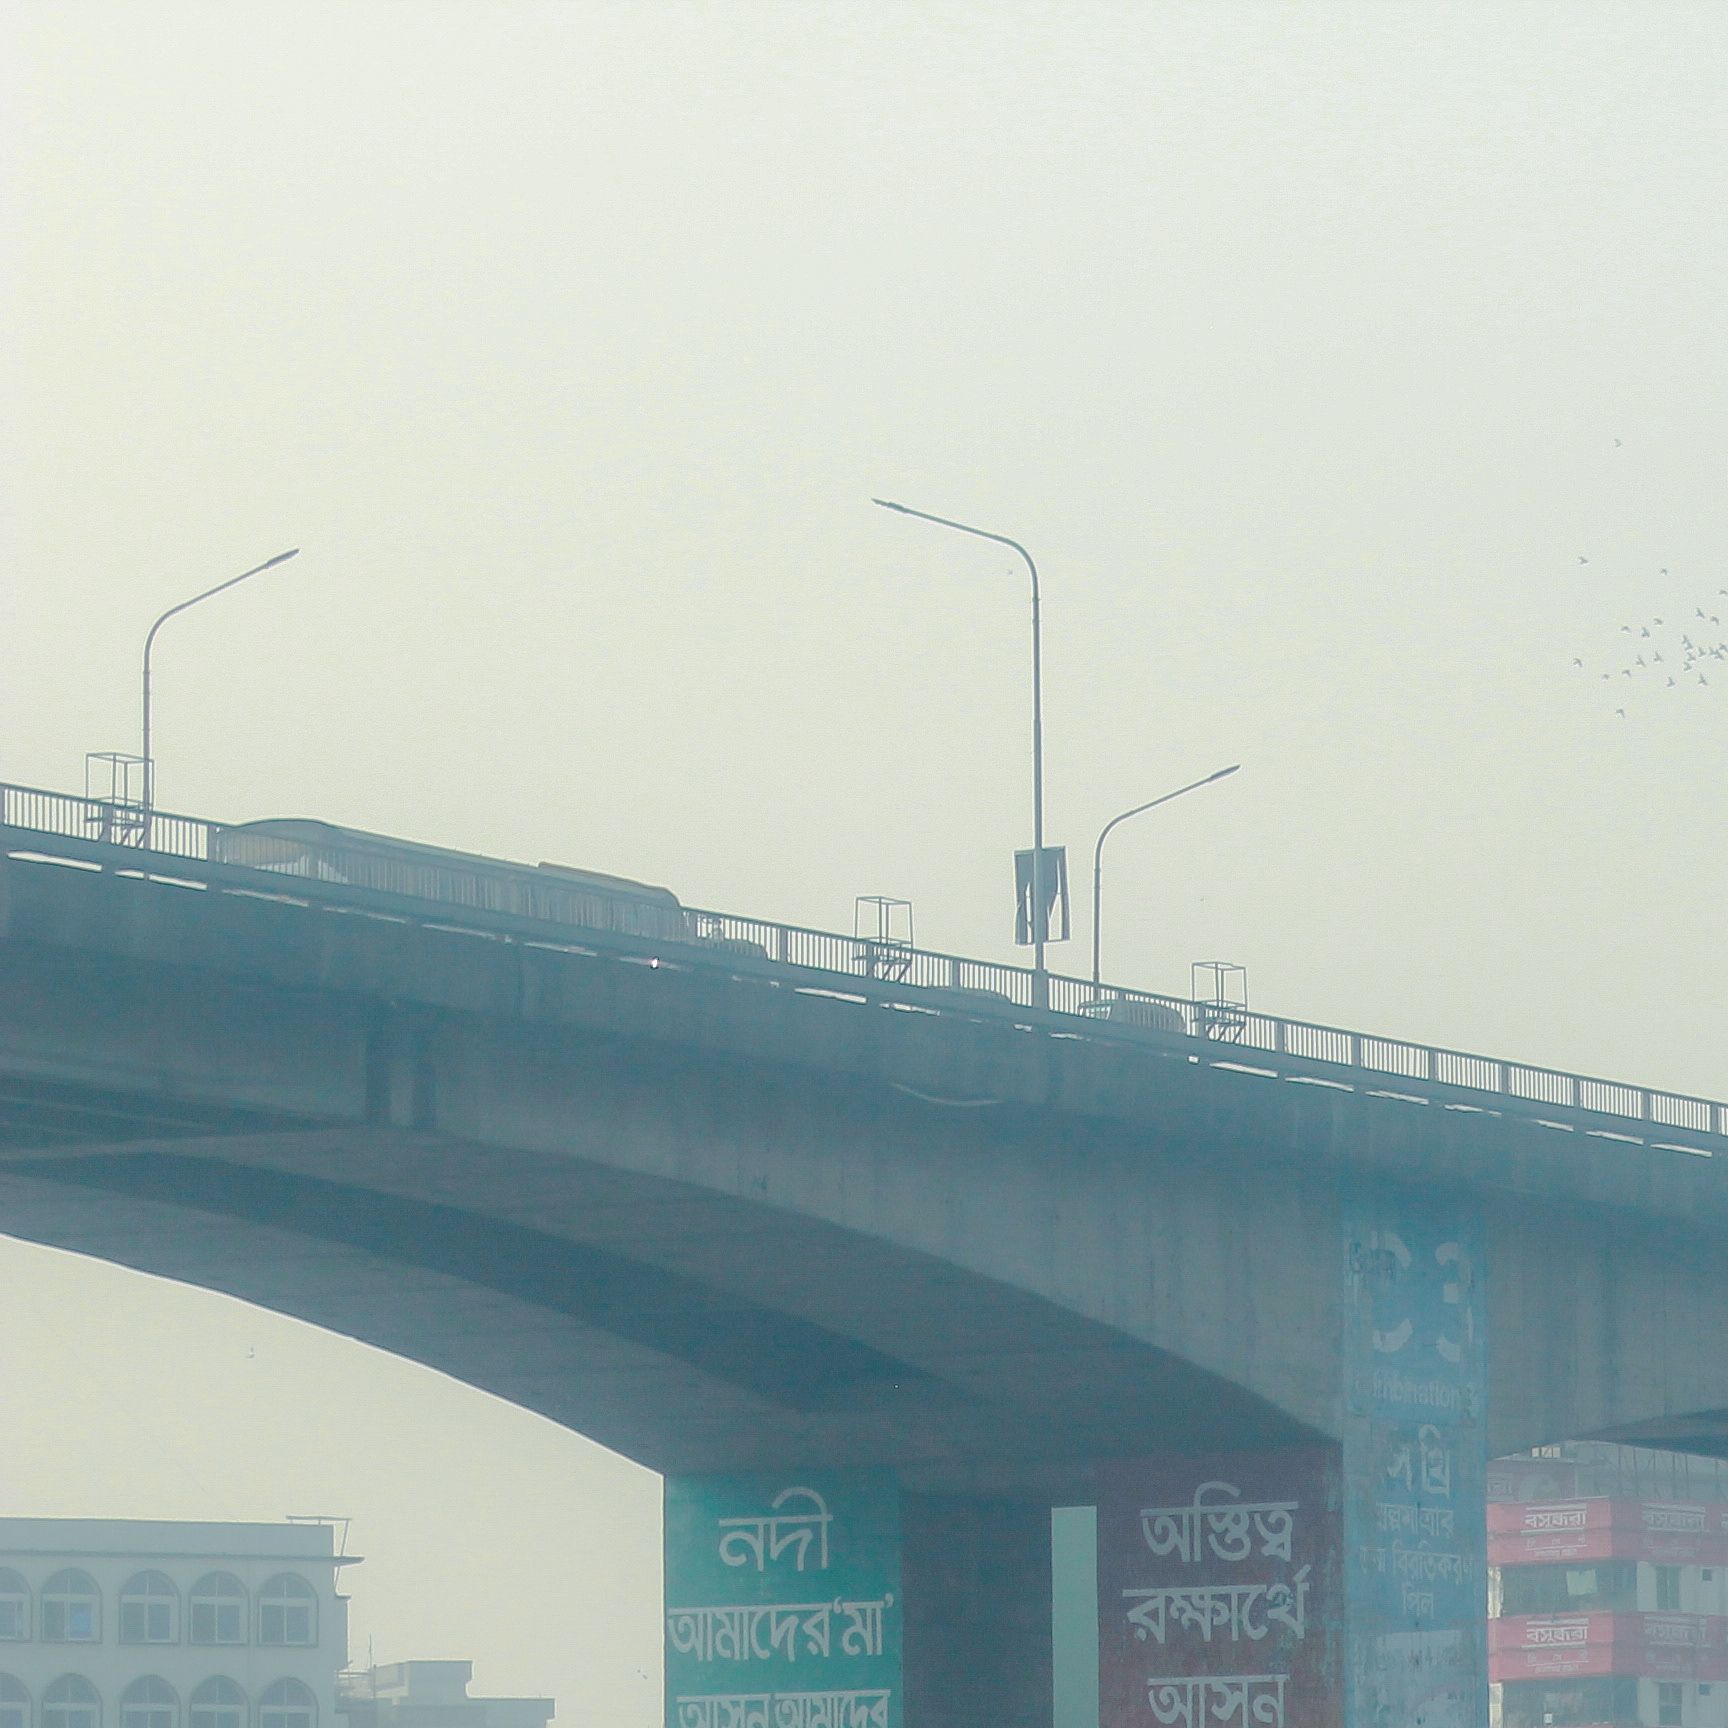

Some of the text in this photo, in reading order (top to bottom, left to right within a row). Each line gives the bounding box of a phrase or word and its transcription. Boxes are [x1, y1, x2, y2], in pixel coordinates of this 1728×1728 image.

[718, 1486, 832, 1573] নদী
[1140, 1481, 1298, 1563] অস্তিত্ব
[669, 1604, 831, 1660] আমাদের
[1122, 1564, 1312, 1643] রক্ষার্থে
